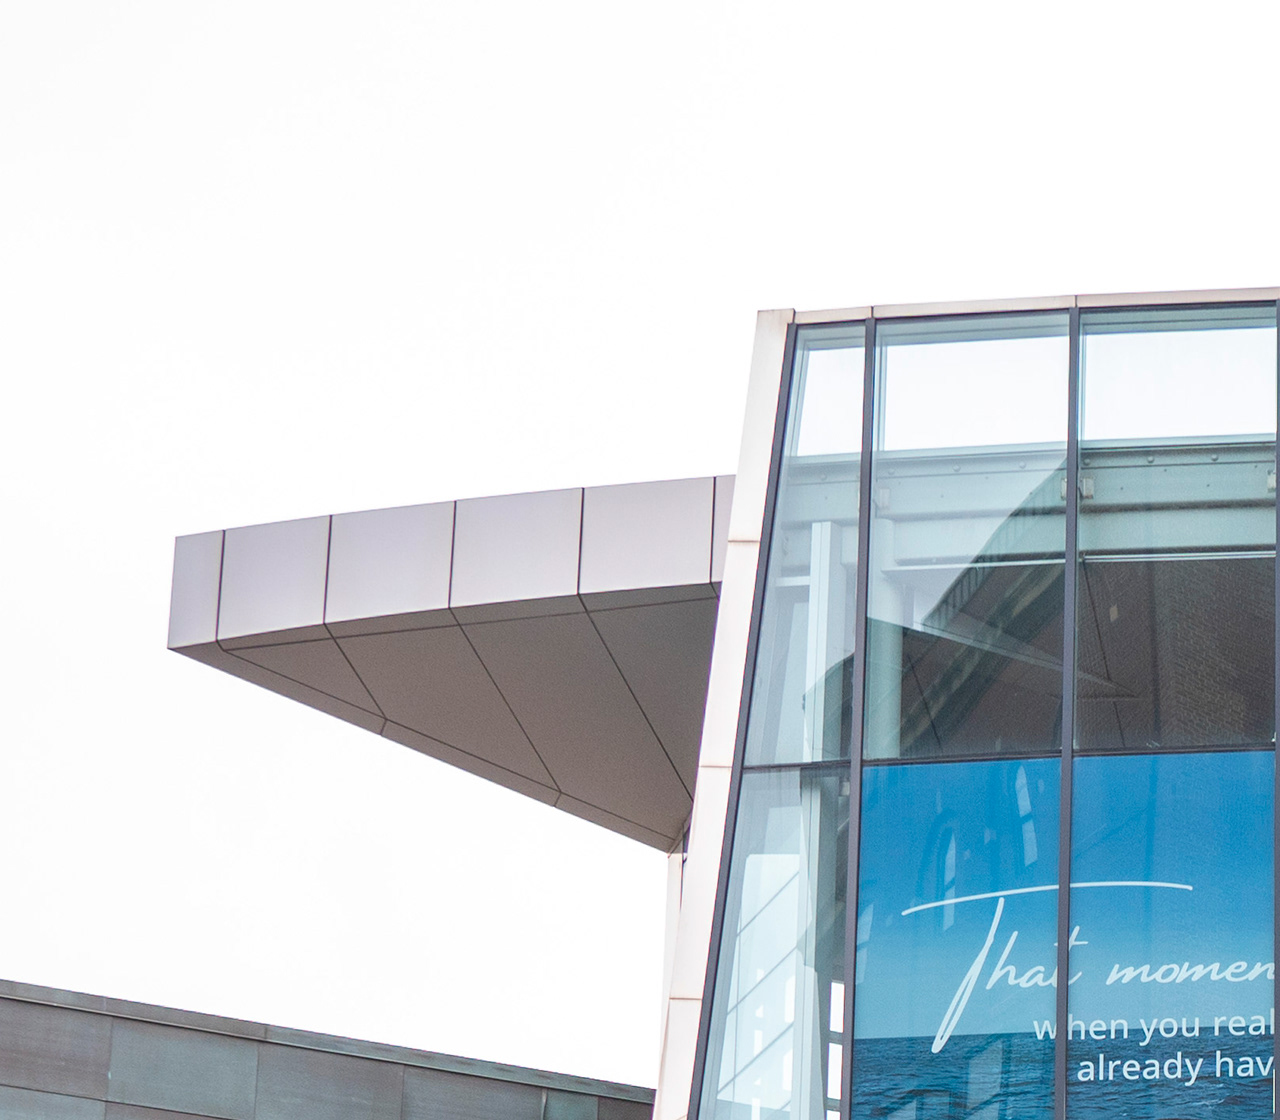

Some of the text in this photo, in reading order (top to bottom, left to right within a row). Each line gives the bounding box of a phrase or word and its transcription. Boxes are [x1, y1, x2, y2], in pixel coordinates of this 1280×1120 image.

[901, 881, 1194, 1053] That
[1033, 1013, 1129, 1040] when
[1139, 1016, 1200, 1046] you
[1077, 1051, 1204, 1087] already
